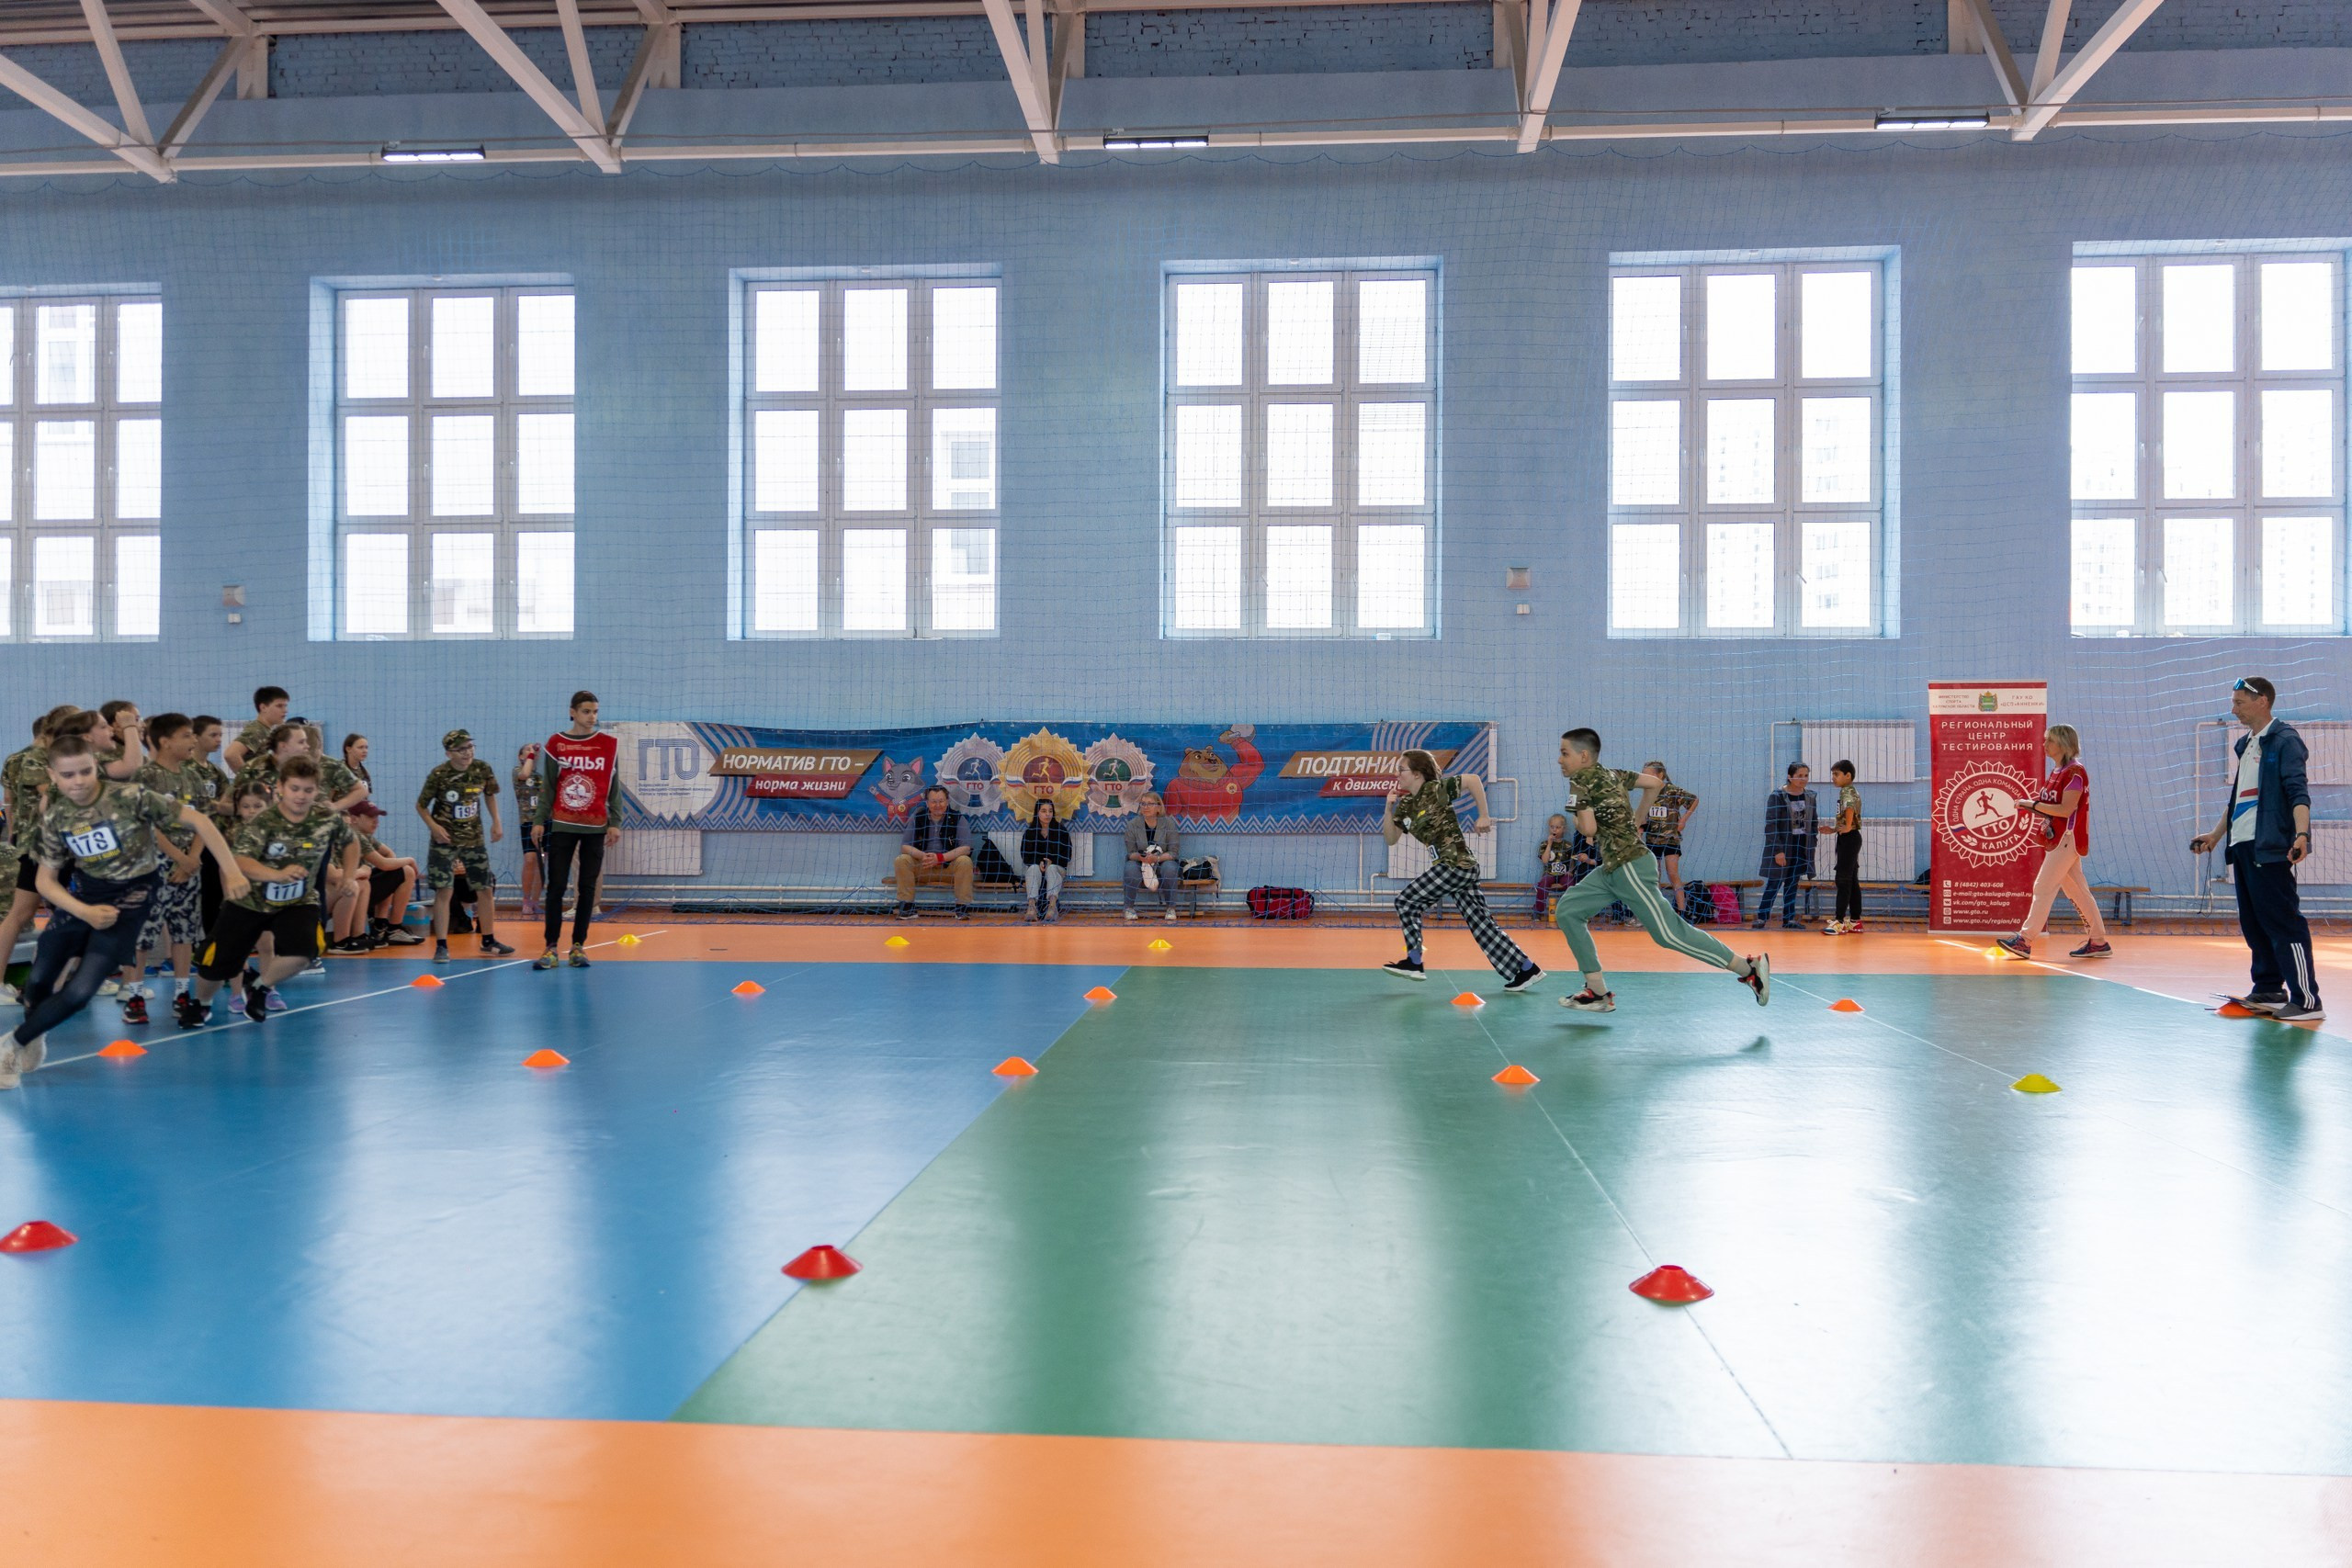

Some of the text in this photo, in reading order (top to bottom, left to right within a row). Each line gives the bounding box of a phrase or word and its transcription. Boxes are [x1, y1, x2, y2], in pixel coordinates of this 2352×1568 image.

[1941, 720, 2033, 729] РЕГИОНАЛЬНЫЙ
[1941, 743, 2033, 751] ТЕСТИРОВАНИЯ
[638, 739, 700, 781] ГТО
[722, 754, 816, 771] НОРМАТИВ
[819, 756, 851, 771] ГТО
[1296, 756, 1397, 776] ПОДТЯНИ
[755, 780, 846, 794] норма жизни
[1034, 785, 1054, 795] ГТО
[1104, 783, 1123, 791] ГТО
[1332, 781, 1341, 790] к
[1973, 779, 1992, 787] ОДНА
[1981, 819, 2010, 836] ГТО
[72, 830, 108, 855] 178
[1981, 834, 2021, 850] КАЛУГА
[273, 882, 299, 899] 177
